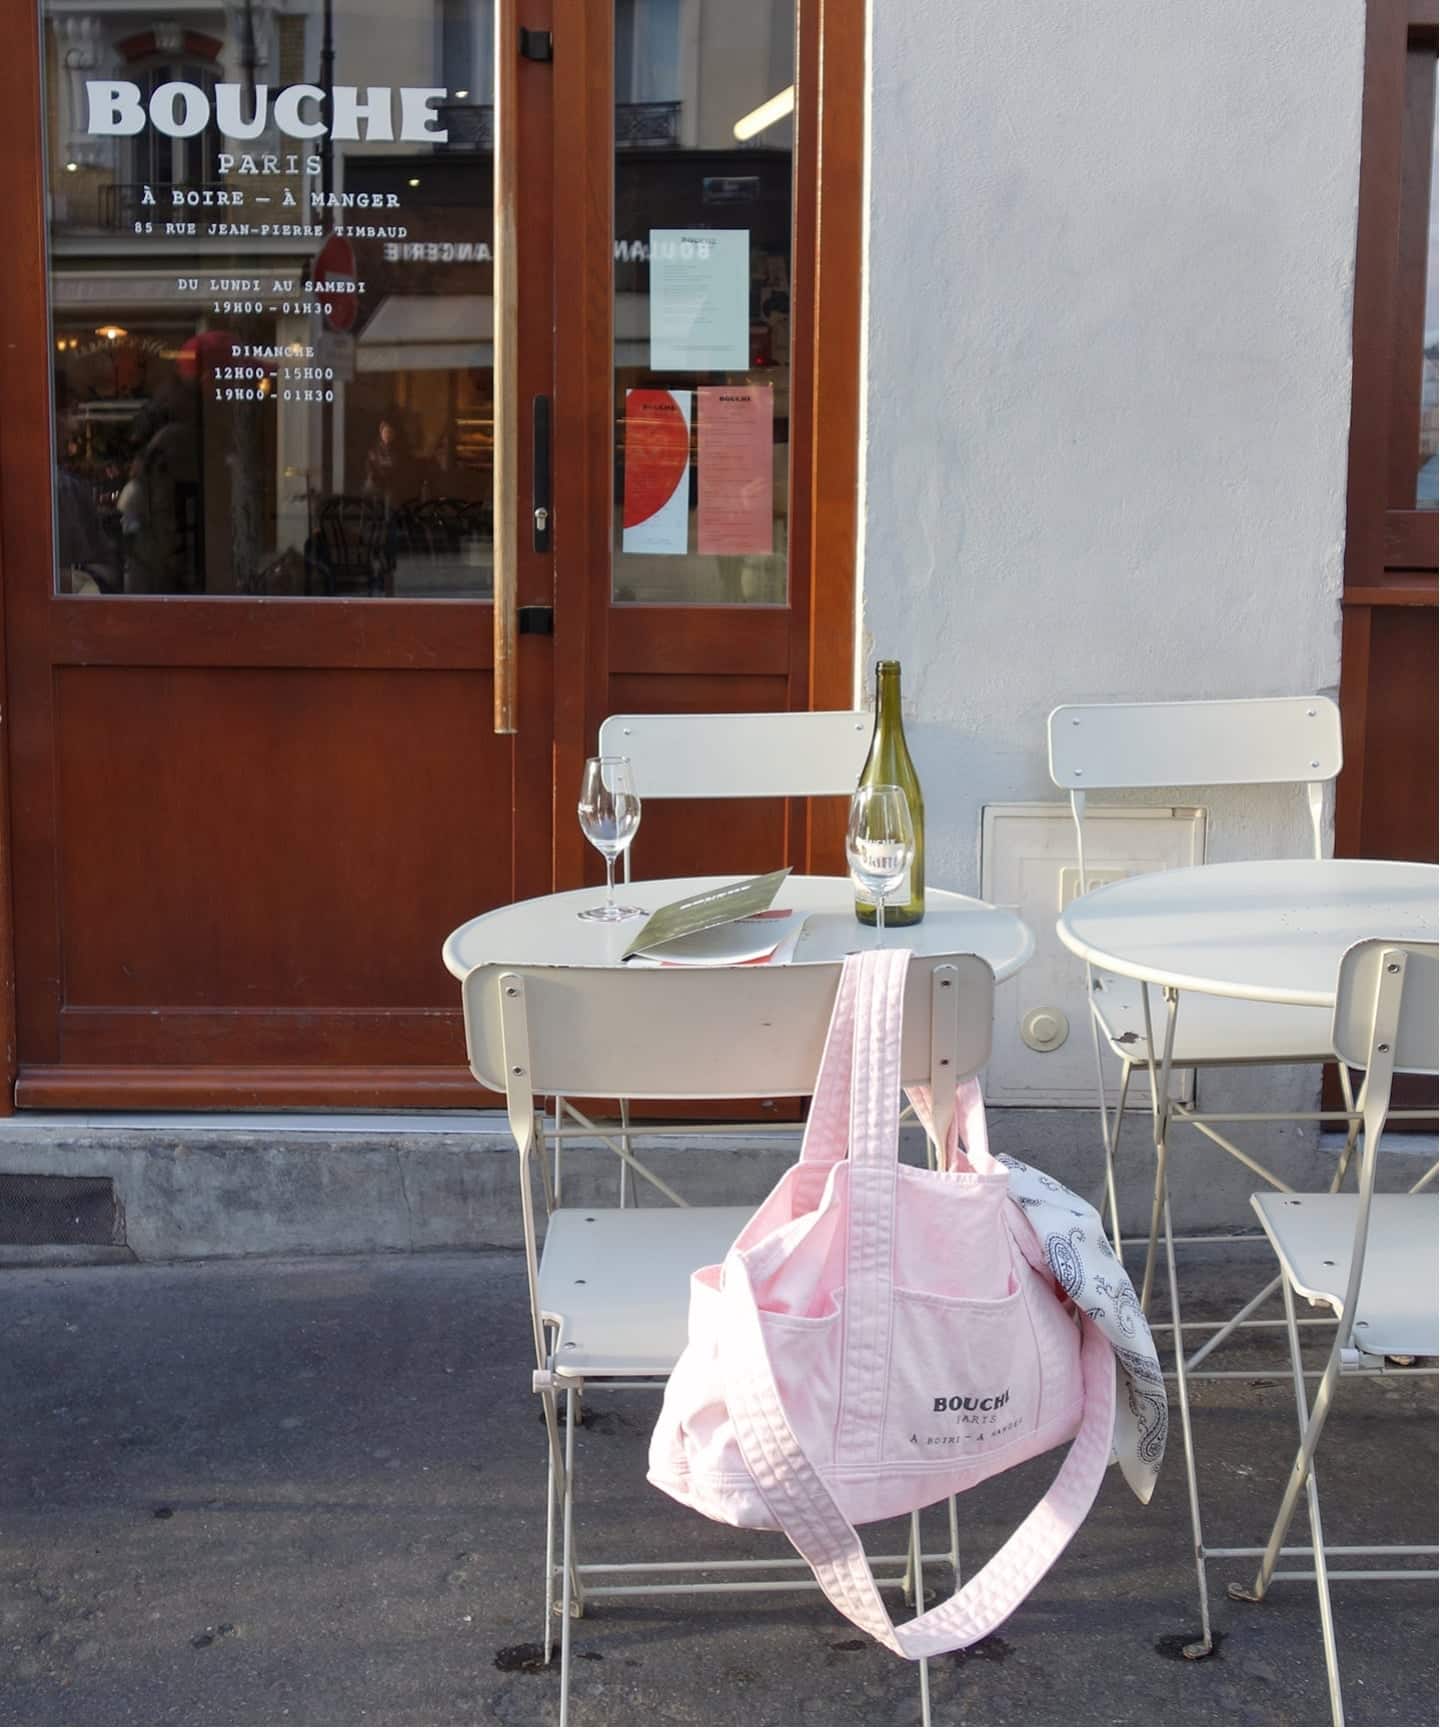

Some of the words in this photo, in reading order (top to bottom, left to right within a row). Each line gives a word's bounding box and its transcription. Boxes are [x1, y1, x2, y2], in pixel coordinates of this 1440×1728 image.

[86, 80, 449, 143] BOUCHE
[218, 153, 321, 174] PARIS
[141, 185, 156, 205] À
[172, 190, 244, 206] BOIRE
[282, 187, 297, 206] À
[311, 192, 400, 208] MANGER
[134, 221, 153, 234] 85
[166, 222, 196, 235] RUE
[208, 223, 323, 237] JEAN-PIERRE
[334, 225, 408, 238] TIMBAUD
[178, 279, 198, 291] DU
[210, 279, 261, 292] LUNDI
[272, 280, 293, 292] AU
[304, 281, 366, 293] SAMEDI
[213, 302, 263, 314] 19H00
[282, 302, 334, 315] 01H30
[231, 345, 315, 358] DIMANCHE
[214, 367, 265, 380] 12H00
[284, 367, 334, 380] 15H00
[215, 388, 265, 401] 19H00
[283, 389, 334, 402] 01H30
